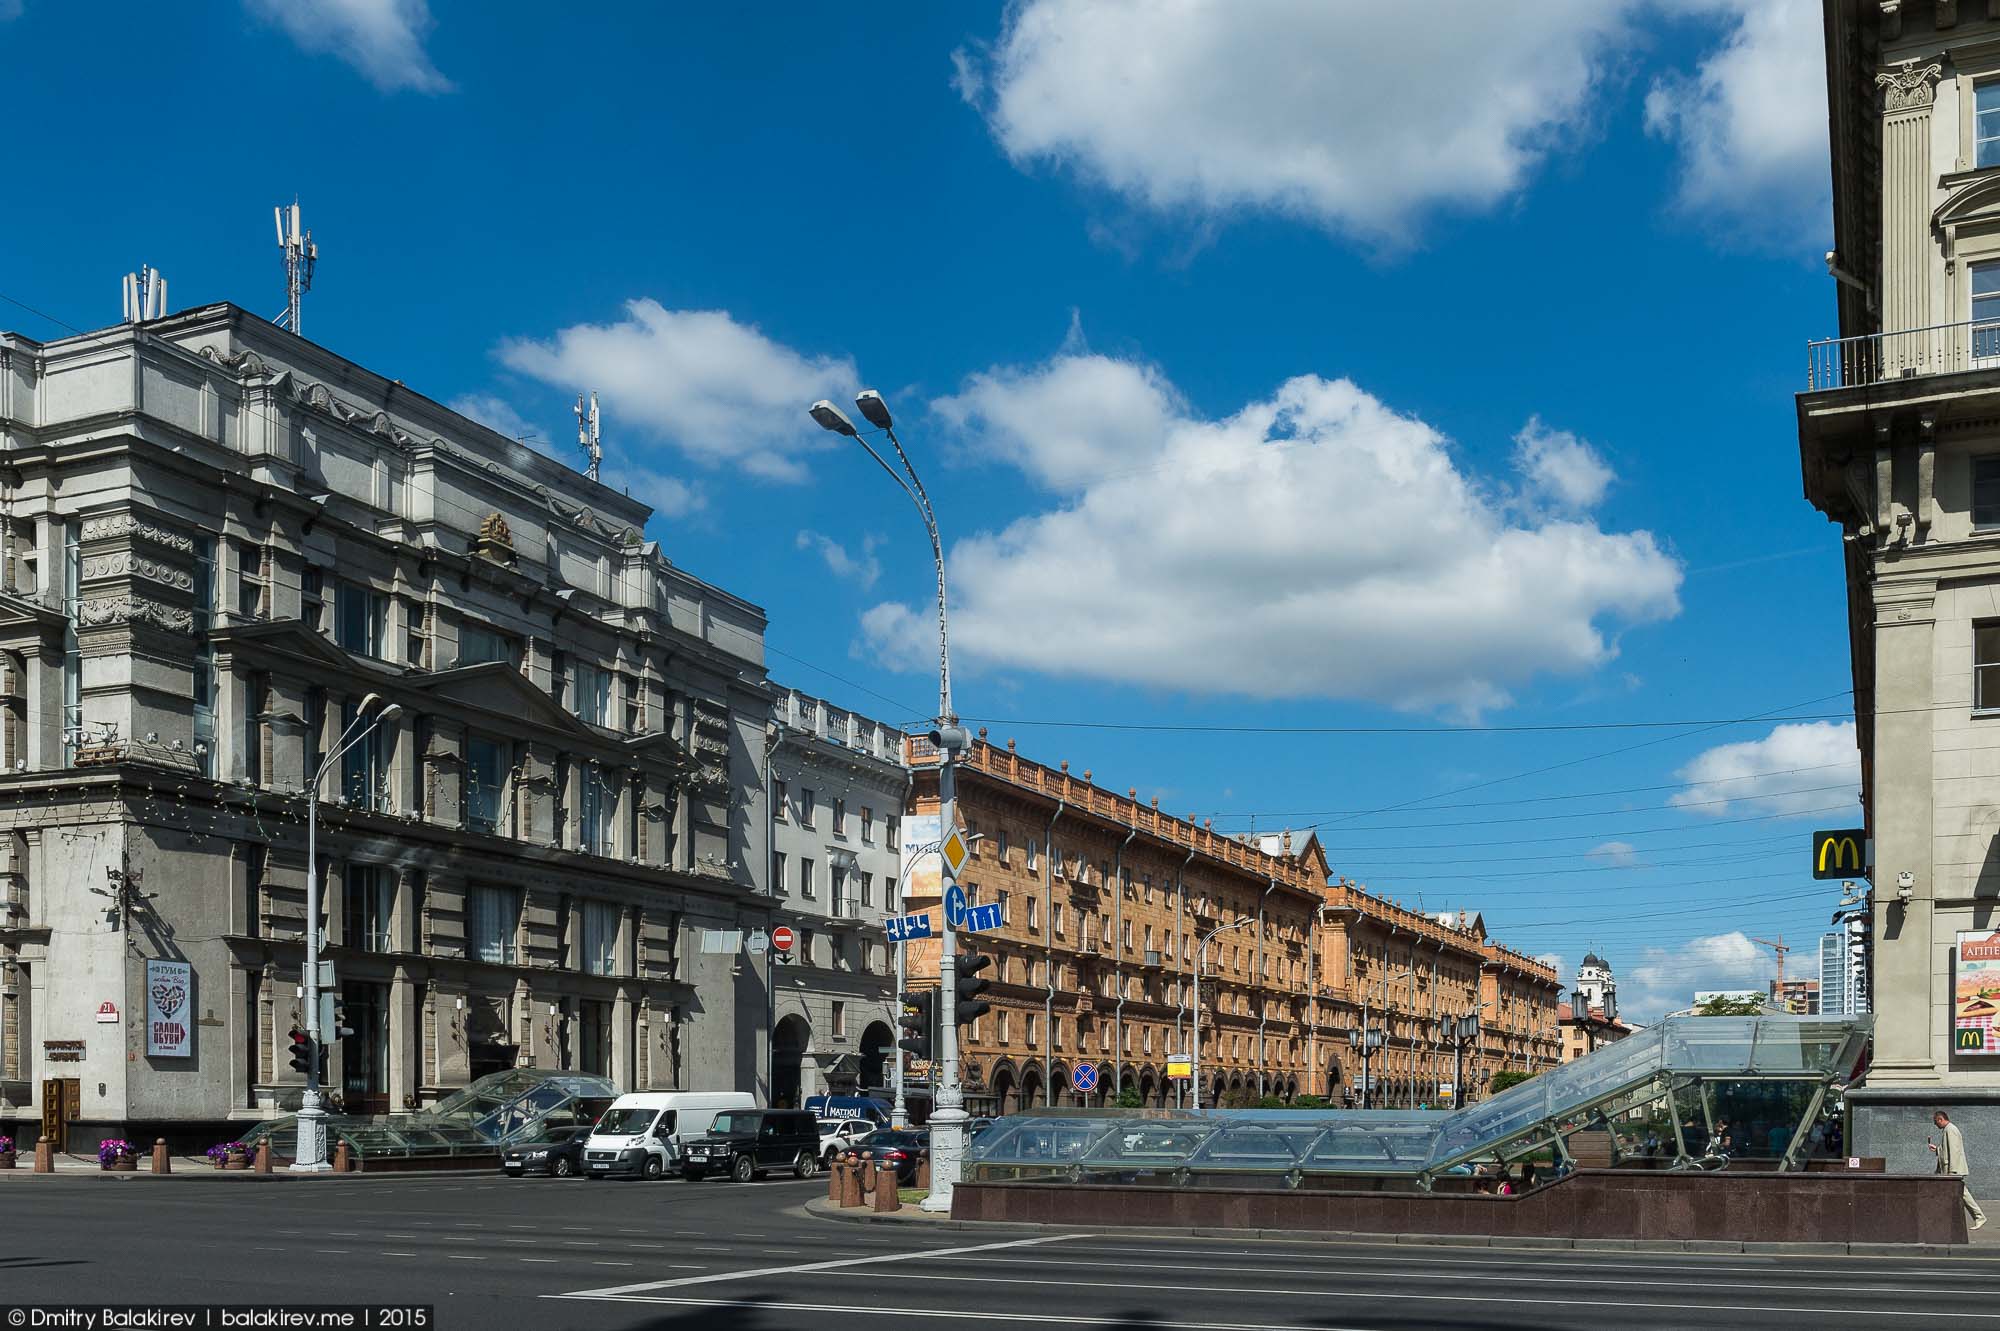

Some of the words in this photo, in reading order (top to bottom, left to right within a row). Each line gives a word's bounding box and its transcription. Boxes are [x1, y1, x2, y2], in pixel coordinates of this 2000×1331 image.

[161, 966, 177, 975] ГУМ
[103, 1003, 110, 1012] 21
[154, 1022, 180, 1033] САЛОН
[154, 1033, 180, 1045] ОБУВИ
